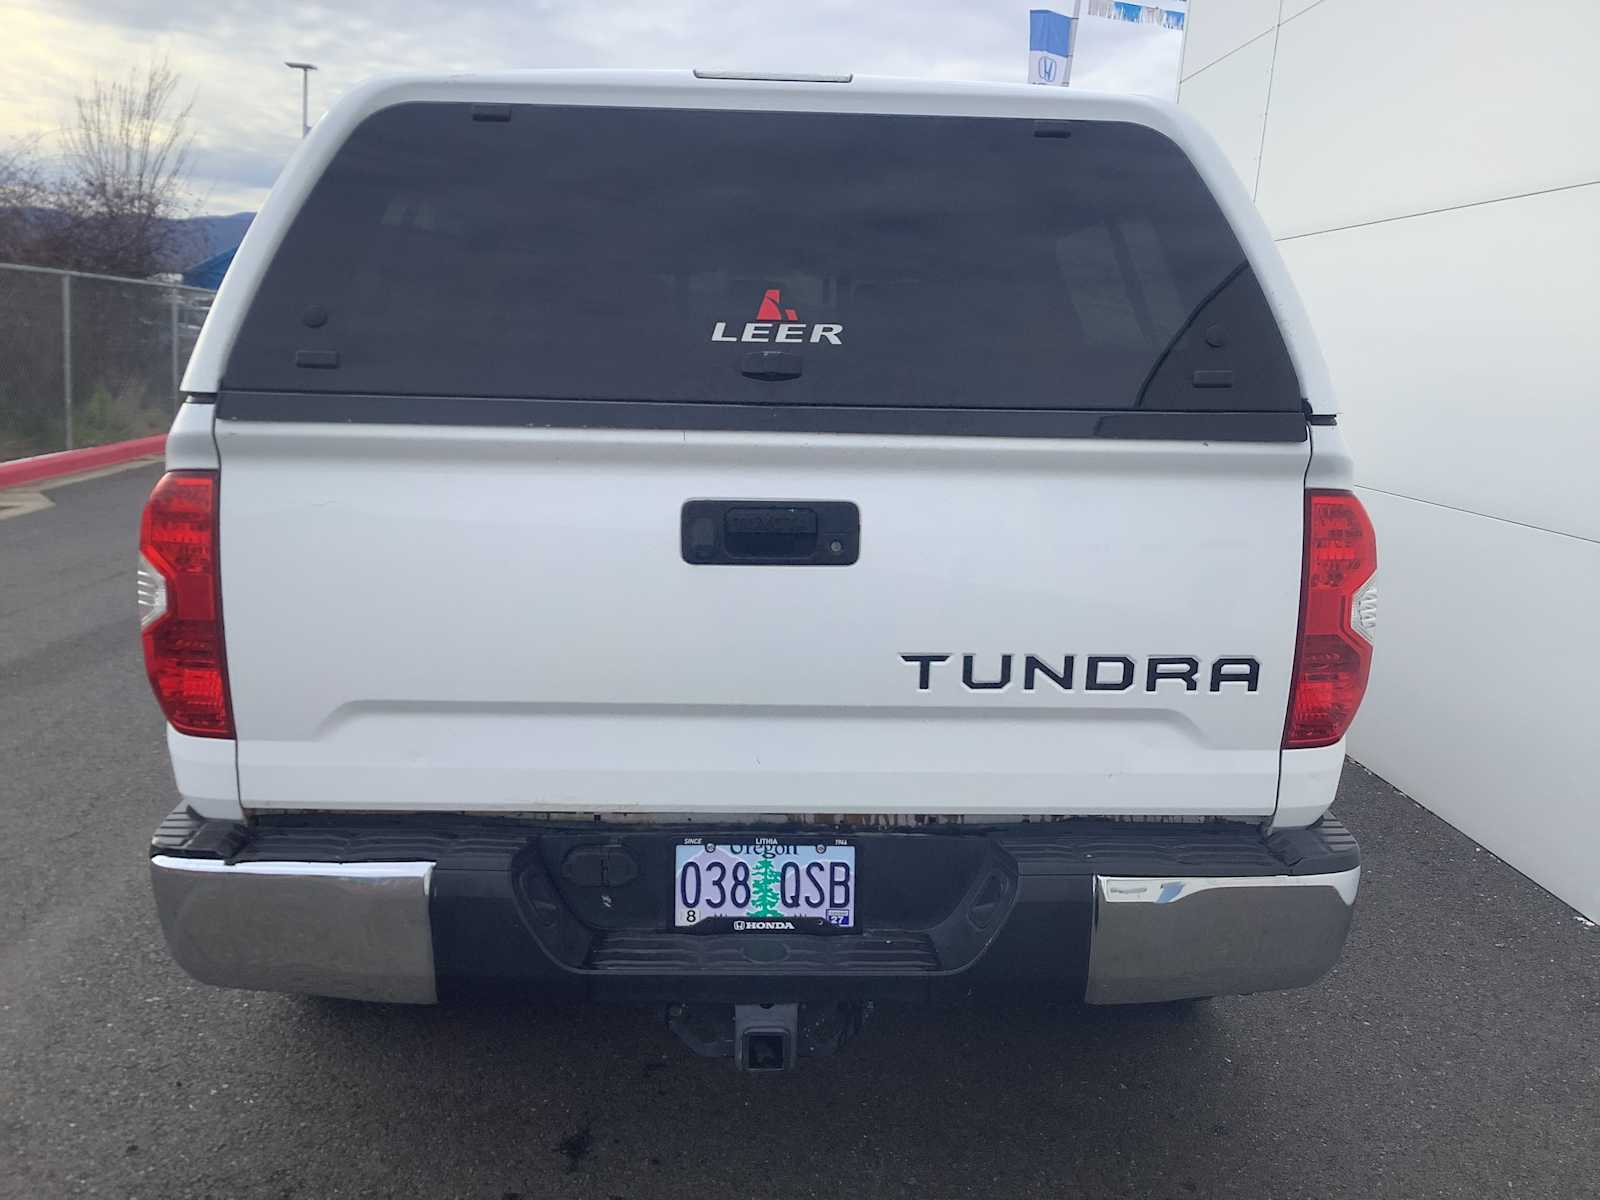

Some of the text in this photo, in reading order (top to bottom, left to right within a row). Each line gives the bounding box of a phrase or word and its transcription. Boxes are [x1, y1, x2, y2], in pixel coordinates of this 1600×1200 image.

[711, 321, 844, 345] LEER
[899, 653, 1262, 694] TUNDRA
[680, 861, 851, 909] 038 QSB
[686, 909, 697, 923] 8
[745, 921, 795, 931] HONDA
